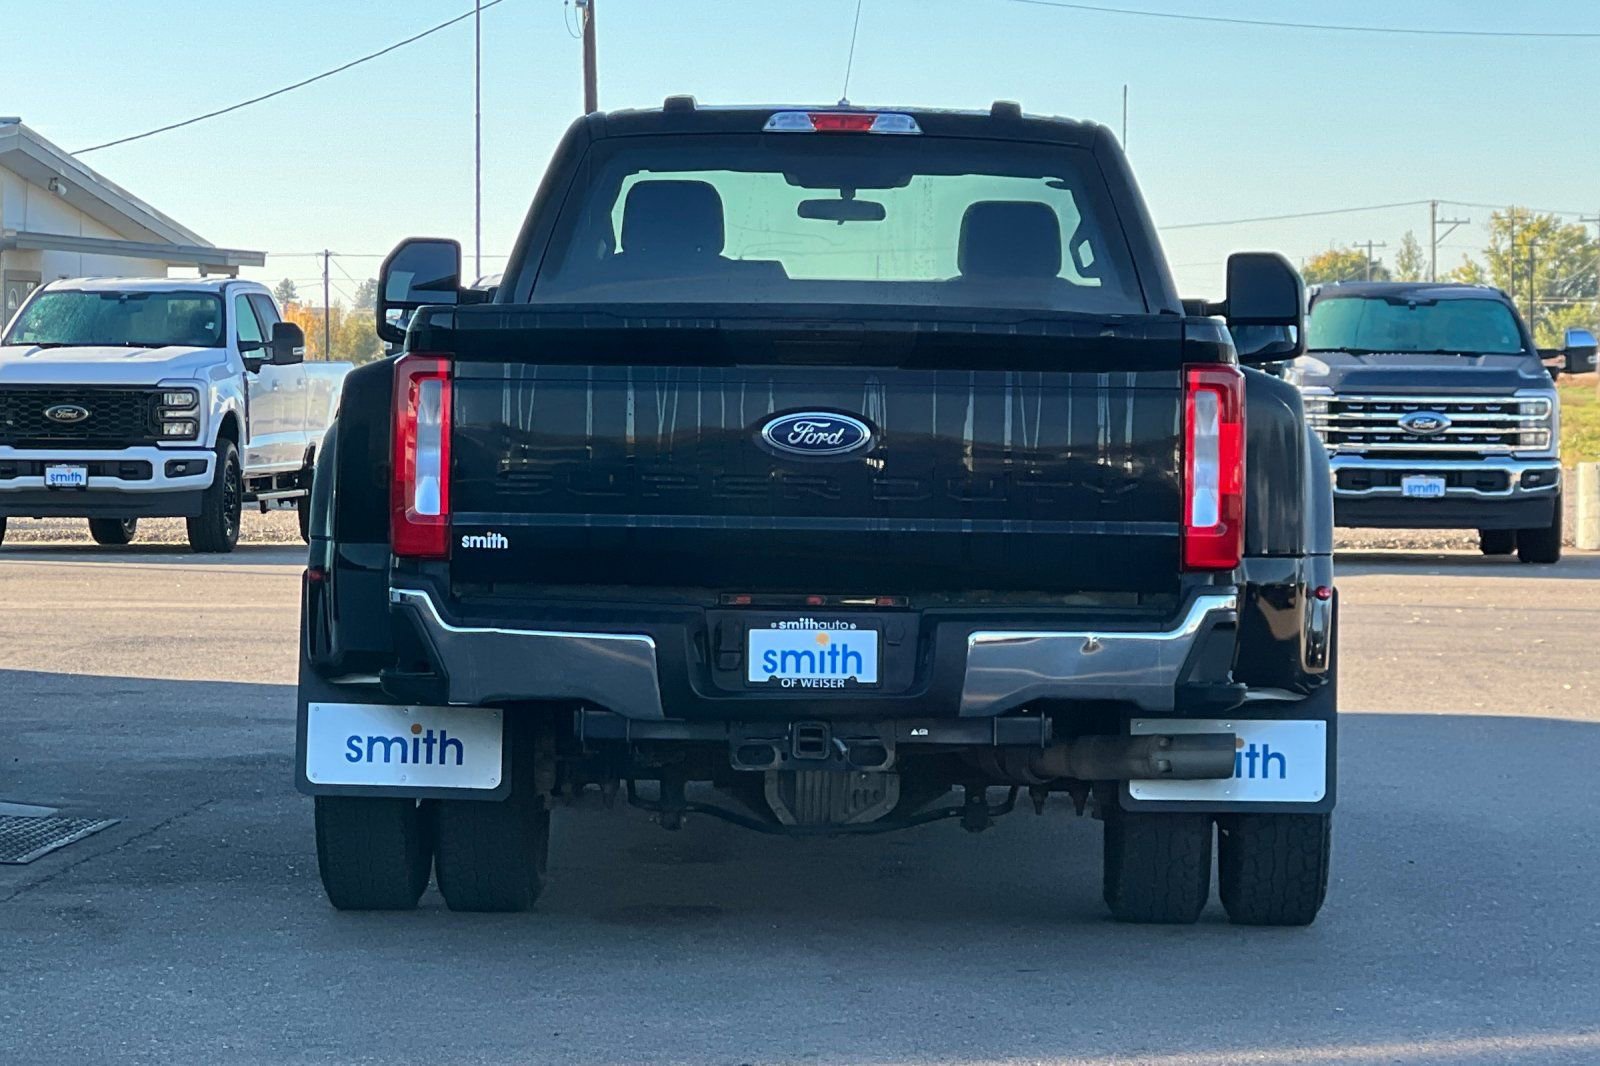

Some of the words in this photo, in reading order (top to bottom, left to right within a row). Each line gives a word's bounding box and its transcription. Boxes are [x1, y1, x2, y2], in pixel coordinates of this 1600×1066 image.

[55, 408, 78, 419] Ford
[787, 421, 845, 445] Ford
[50, 467, 82, 483] smith
[1407, 479, 1441, 494] smith
[461, 531, 508, 549] smith
[762, 632, 863, 674] smith
[781, 678, 798, 688] OF
[800, 678, 845, 688] WEISER
[345, 723, 464, 766] smith
[1235, 737, 1287, 779] ith
